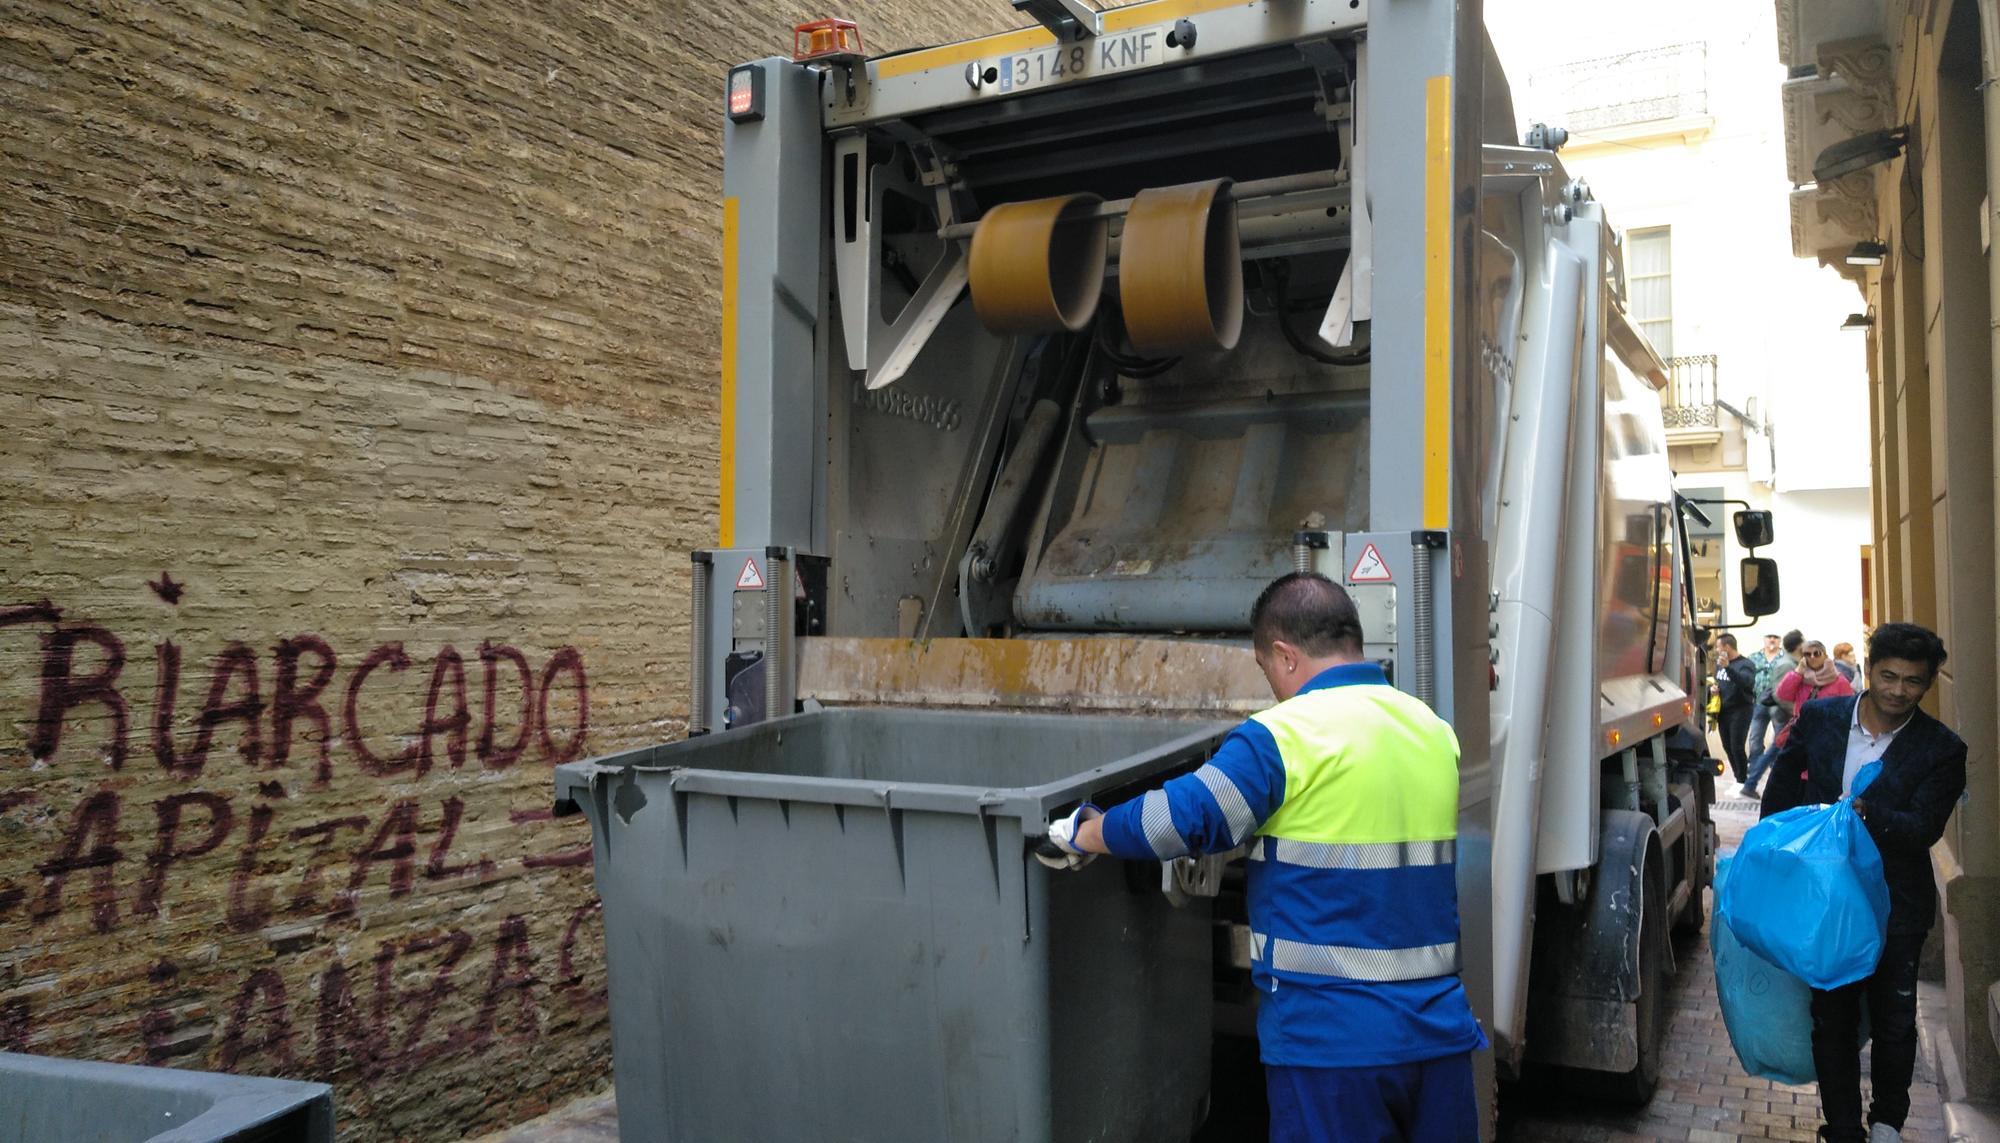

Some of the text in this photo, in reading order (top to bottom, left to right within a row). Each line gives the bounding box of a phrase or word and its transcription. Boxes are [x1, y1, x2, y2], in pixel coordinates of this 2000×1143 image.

[1015, 46, 1085, 86] 3148
[1101, 32, 1157, 70] KNF
[0, 597, 590, 787] RIARCADO
